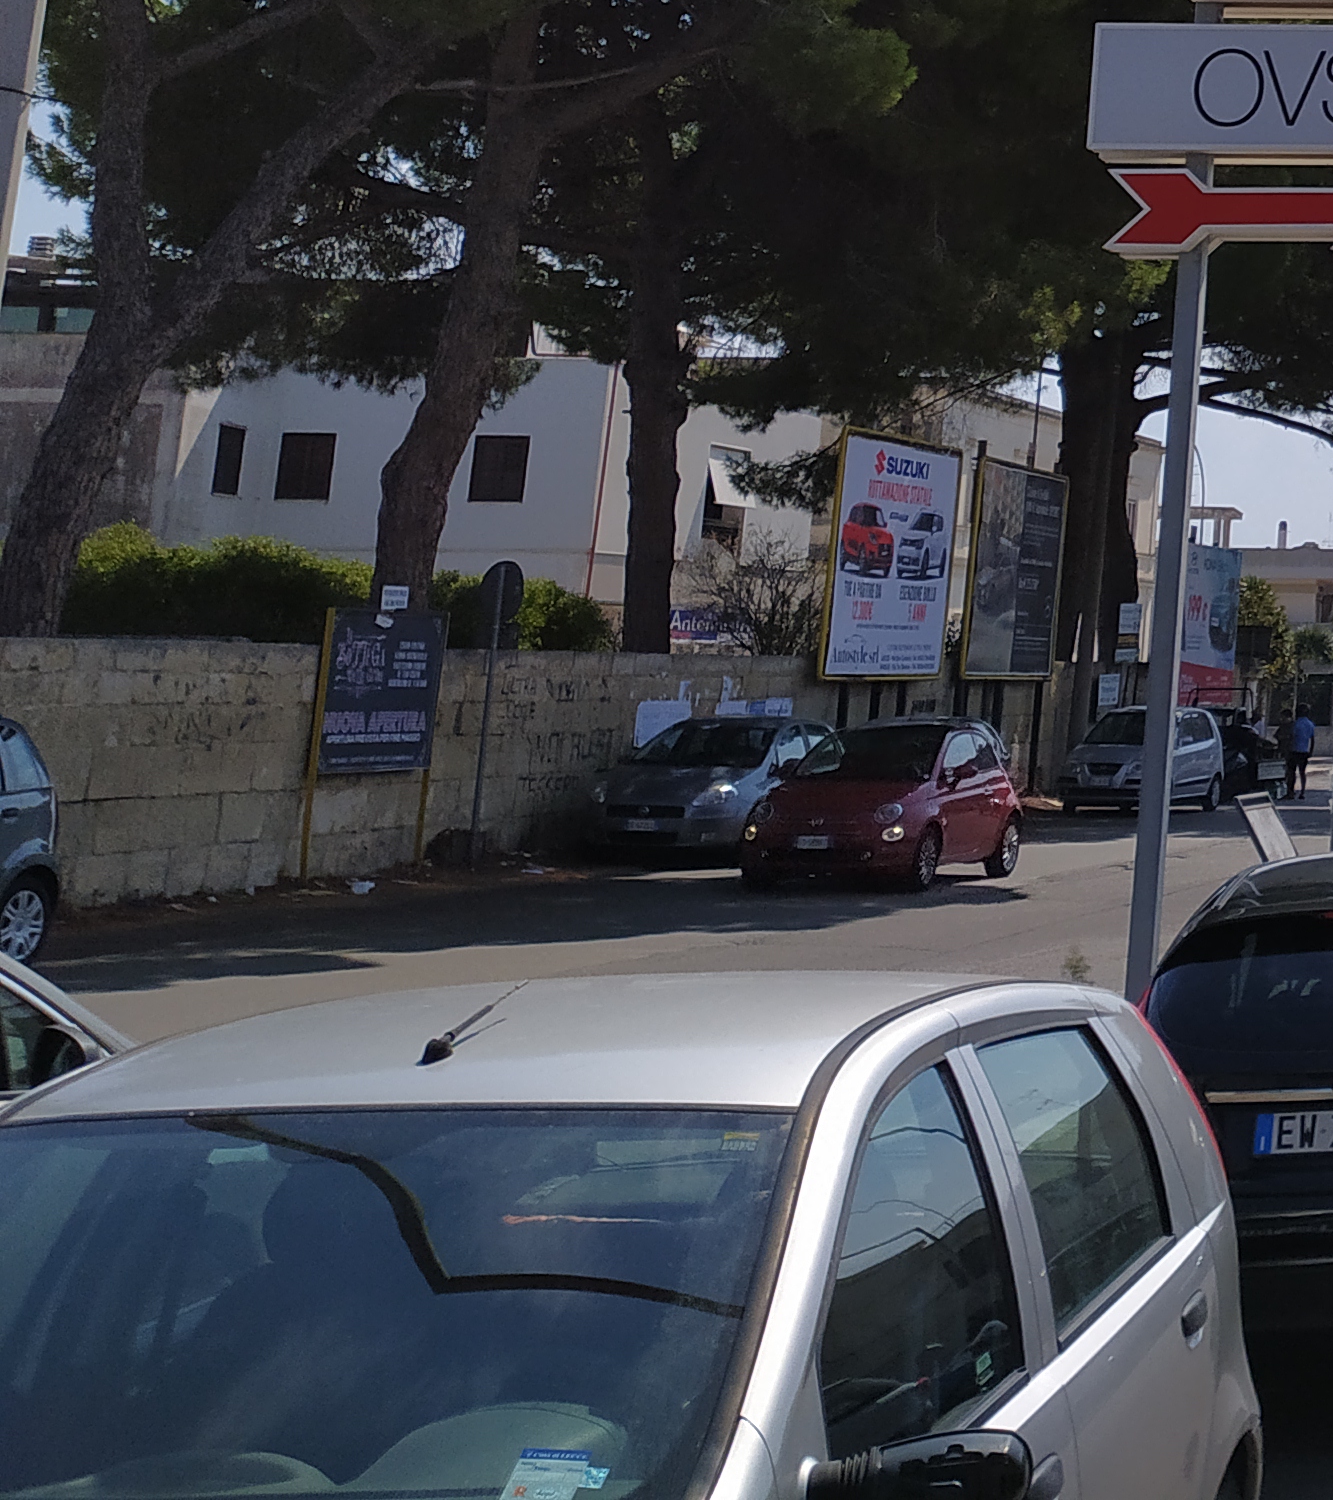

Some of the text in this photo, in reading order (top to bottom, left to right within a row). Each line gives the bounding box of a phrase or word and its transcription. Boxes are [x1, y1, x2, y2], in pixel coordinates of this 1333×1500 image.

[886, 455, 930, 480] SUZUKI
[322, 710, 427, 734] NUOVA APERTURA
[1276, 1115, 1318, 1150] EW
